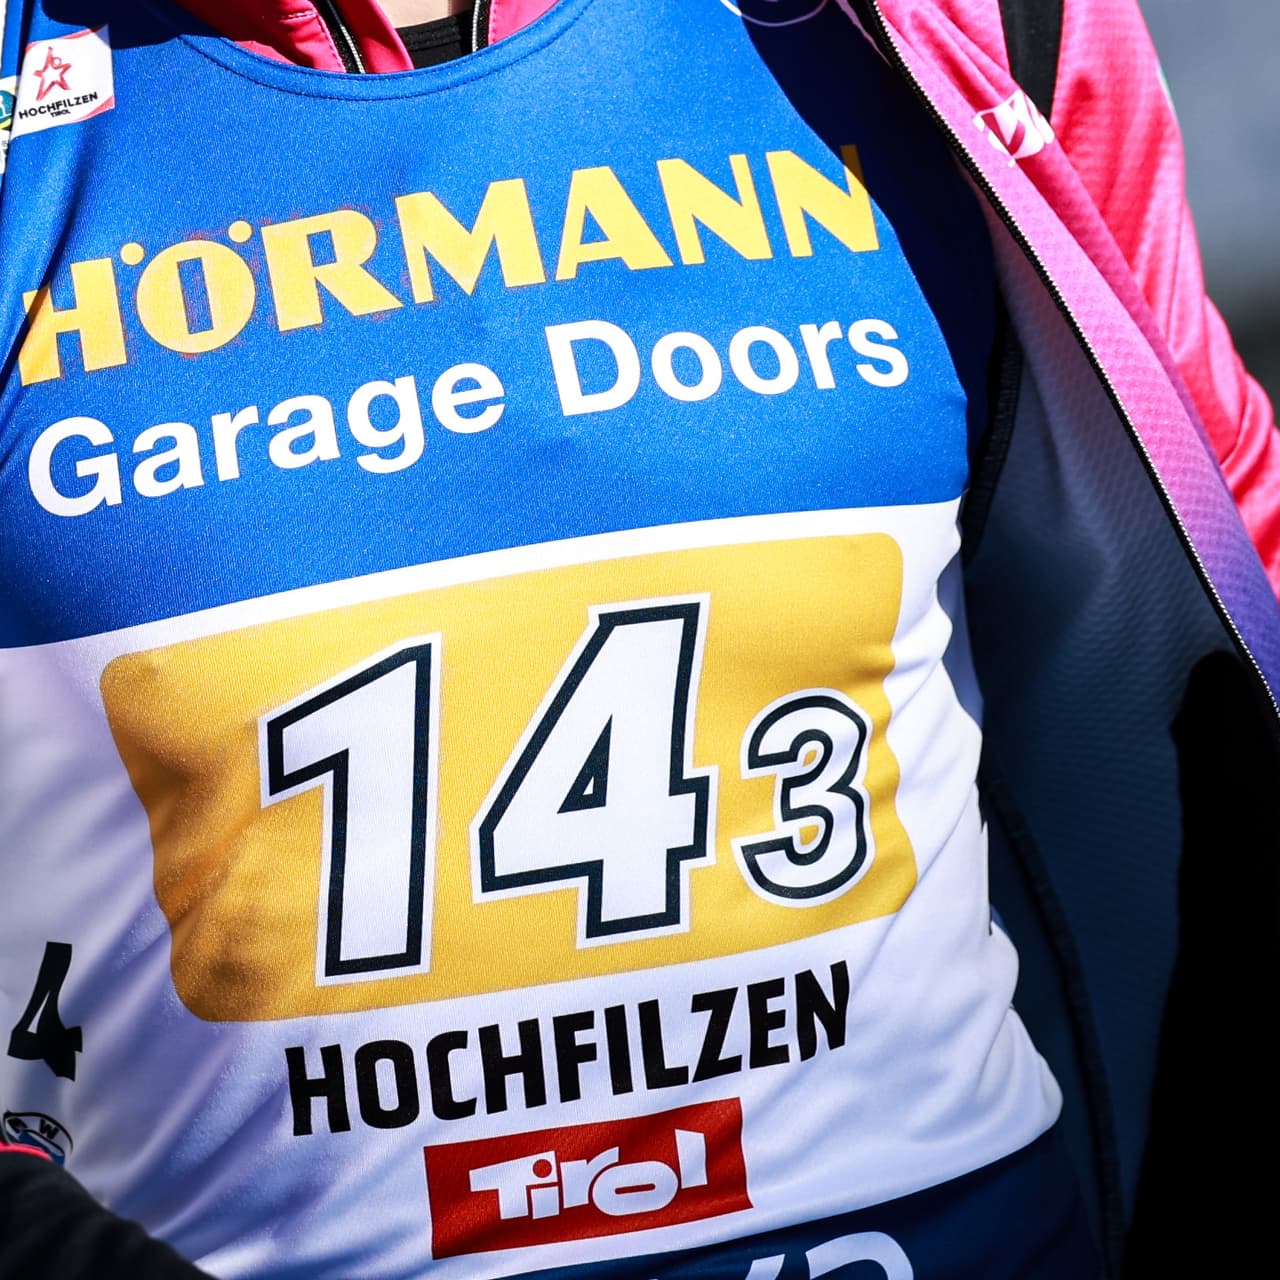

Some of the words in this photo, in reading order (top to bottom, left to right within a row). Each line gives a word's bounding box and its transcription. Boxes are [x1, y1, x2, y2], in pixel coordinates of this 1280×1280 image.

[18, 91, 99, 120] HOCHFILZEN
[17, 144, 879, 386] HÖRMANN
[26, 362, 504, 518] Garage
[545, 318, 909, 417] Doors
[259, 593, 717, 986] 14
[733, 688, 874, 908] 3
[286, 960, 851, 1137] HOCHFILZEN
[469, 1130, 709, 1221] Tirol
